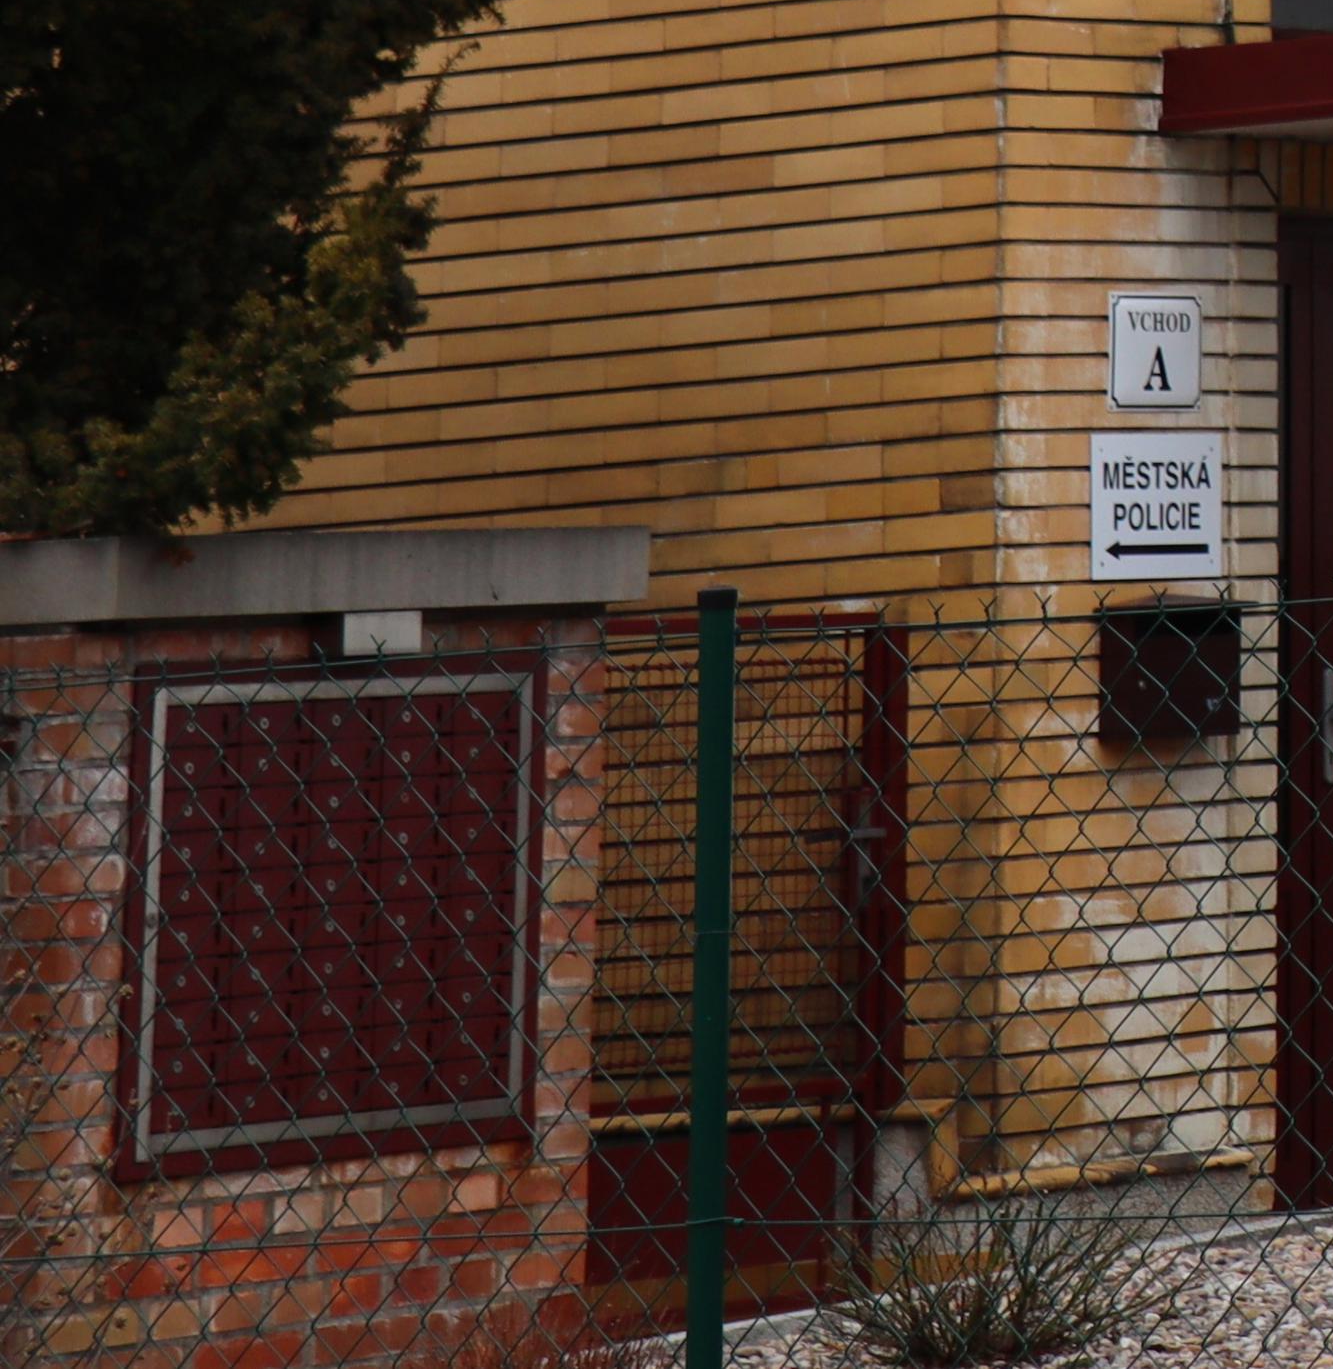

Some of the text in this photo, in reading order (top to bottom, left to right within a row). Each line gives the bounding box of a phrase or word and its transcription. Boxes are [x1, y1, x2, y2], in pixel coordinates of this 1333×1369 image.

[1127, 311, 1192, 333] VCHOD
[1143, 345, 1172, 392] A
[1102, 455, 1212, 490] MĚSTSKÁ
[1112, 502, 1201, 532] POLICIE
